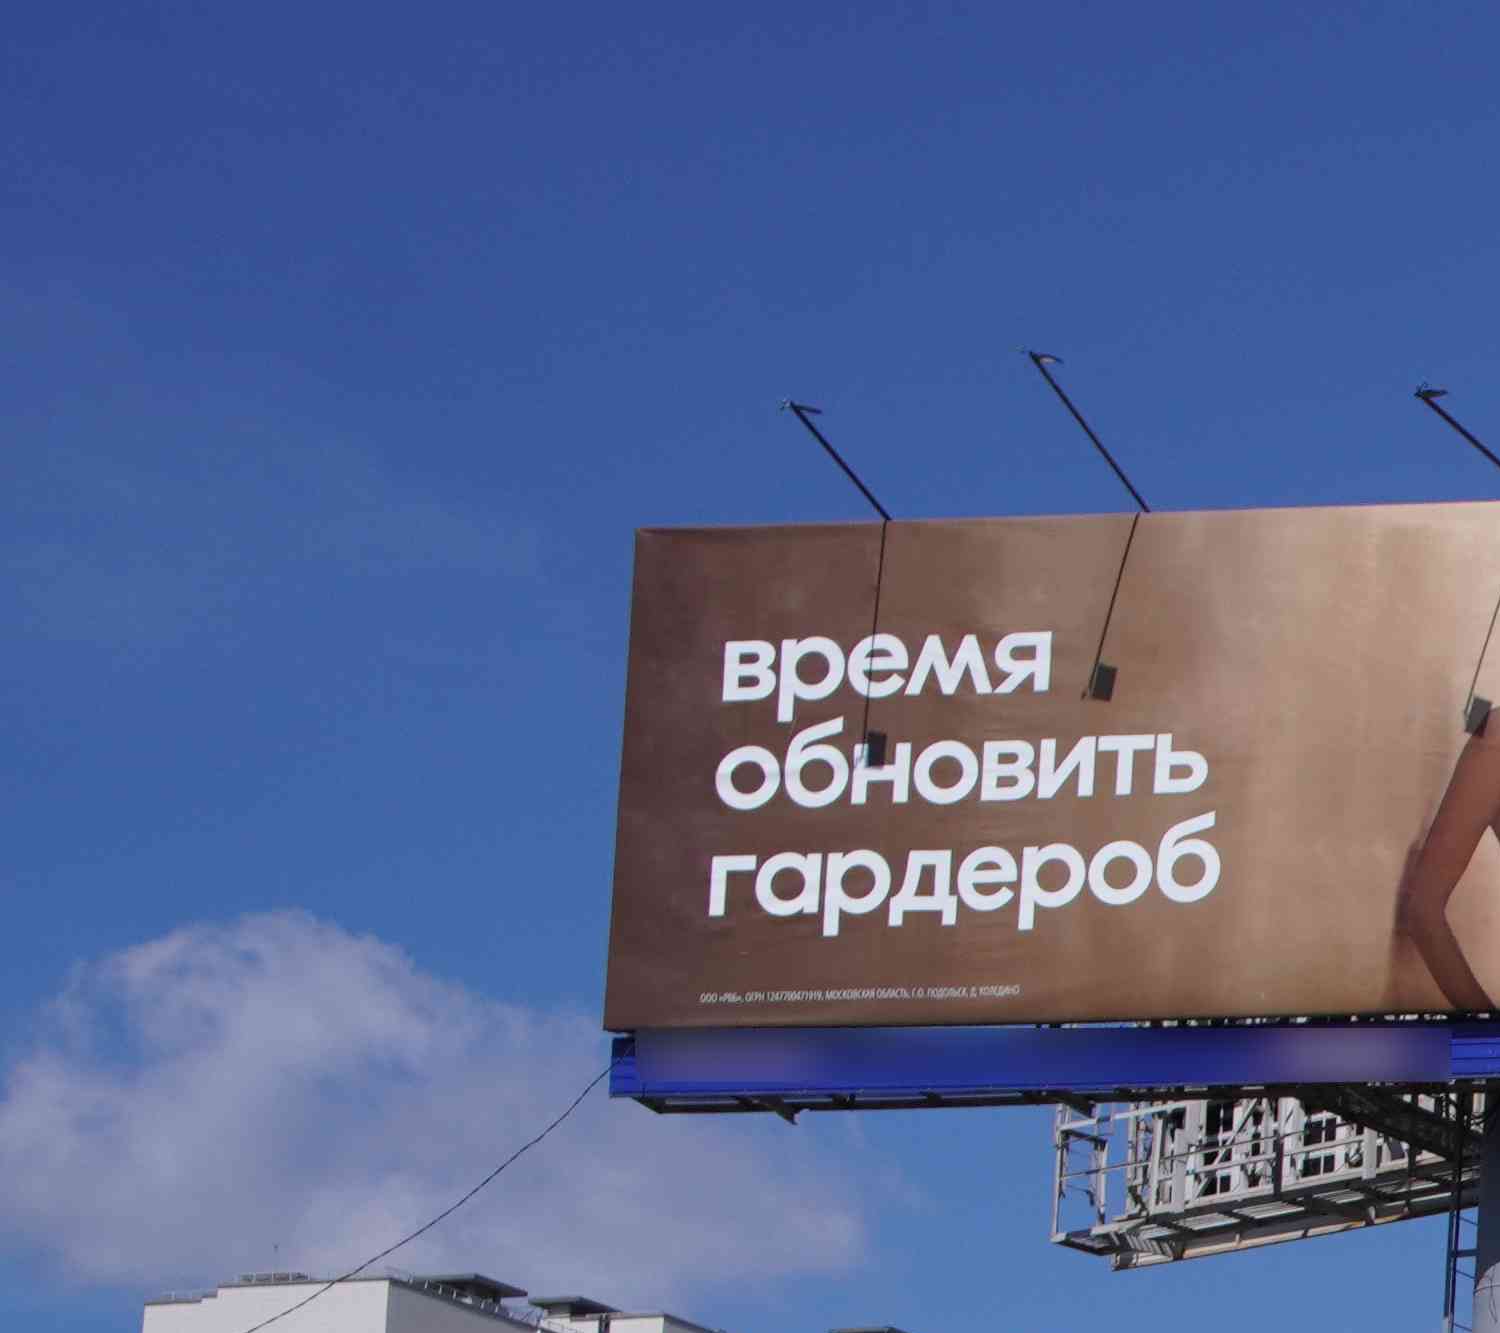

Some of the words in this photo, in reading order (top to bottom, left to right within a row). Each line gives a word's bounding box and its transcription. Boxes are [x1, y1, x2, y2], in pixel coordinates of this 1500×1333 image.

[722, 631, 1053, 722] время
[715, 716, 1209, 811] обновить
[709, 811, 1221, 937] гардероб
